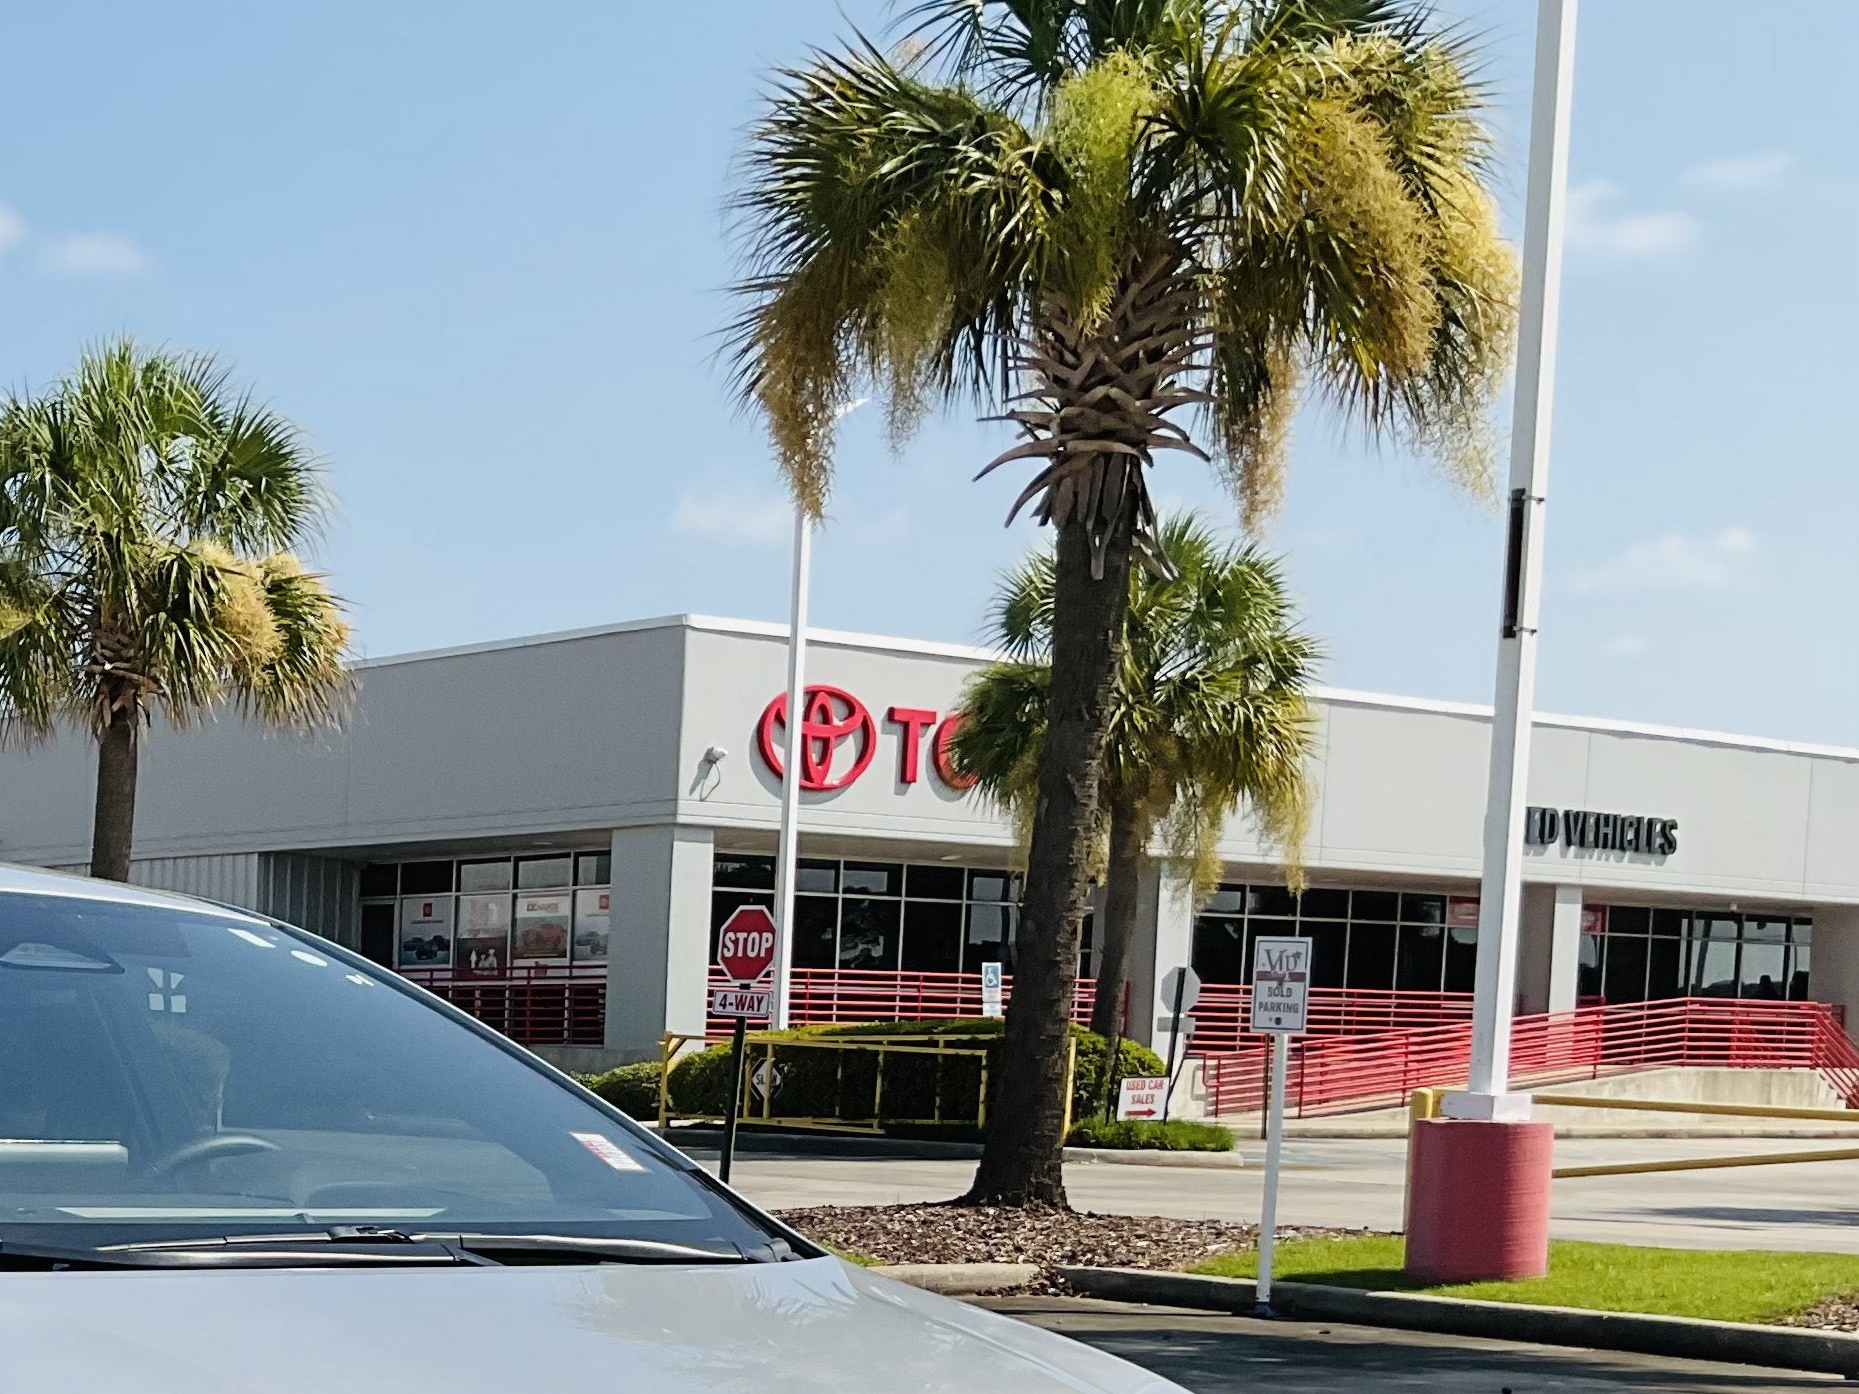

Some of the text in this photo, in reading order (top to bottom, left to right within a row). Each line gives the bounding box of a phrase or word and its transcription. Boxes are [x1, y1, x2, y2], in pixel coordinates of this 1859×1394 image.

[1563, 810, 1678, 855] VEHICLES
[723, 931, 774, 958] STOP
[1267, 986, 1293, 998] SOLD
[719, 994, 764, 1013] 4-WAY
[1258, 1002, 1299, 1014] PARKING
[756, 1073, 778, 1085] SLW
[1126, 1080, 1164, 1090] USED CAR
[1131, 1094, 1155, 1104] SALES
